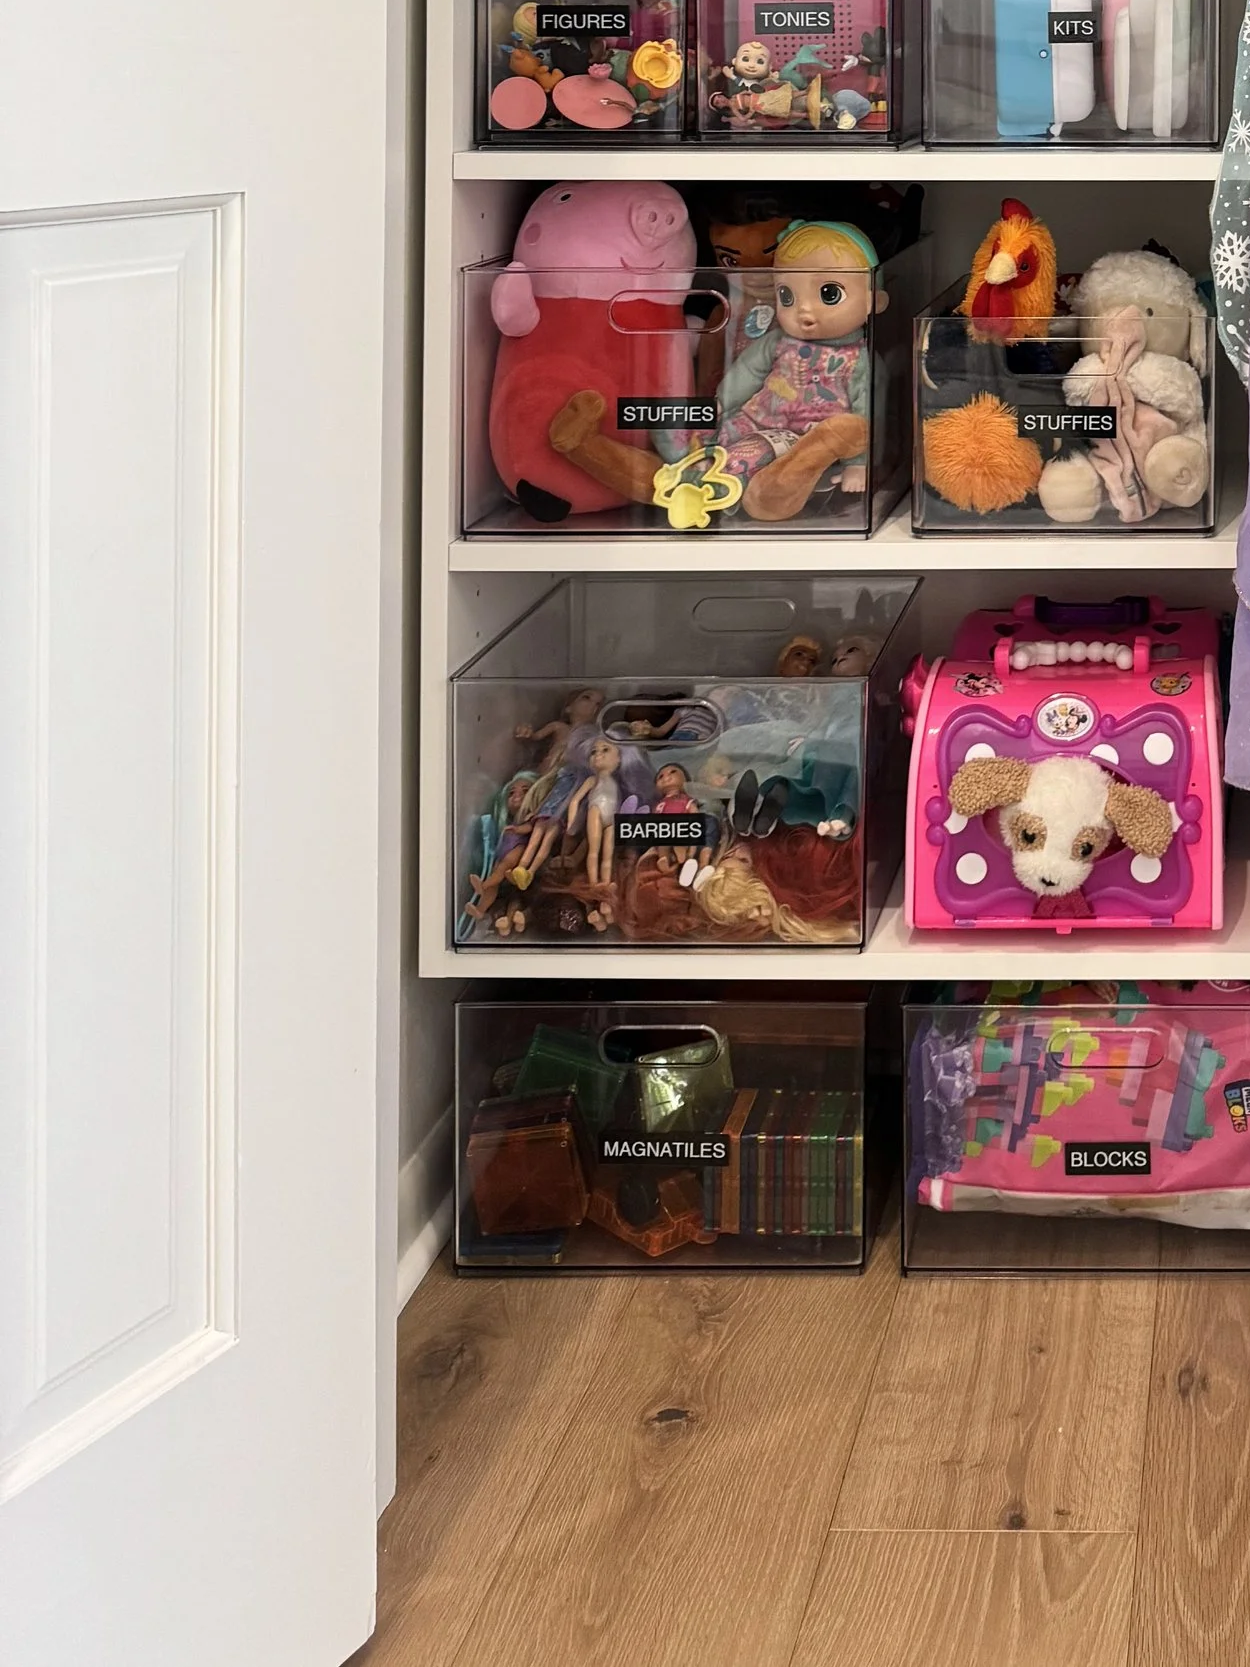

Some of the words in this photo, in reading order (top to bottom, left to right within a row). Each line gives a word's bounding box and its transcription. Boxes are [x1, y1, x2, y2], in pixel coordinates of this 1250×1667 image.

[543, 14, 625, 28] FIGURES
[760, 12, 829, 26] TONIES
[1054, 21, 1093, 35] KITS
[624, 407, 713, 421] STUFFIES
[1024, 415, 1112, 430] STUFFIES
[621, 822, 701, 838] BARBIES
[1226, 1088, 1247, 1133] BLOKS
[605, 1142, 725, 1158] MAGNATILES
[1071, 1151, 1146, 1166] BLOCKS
